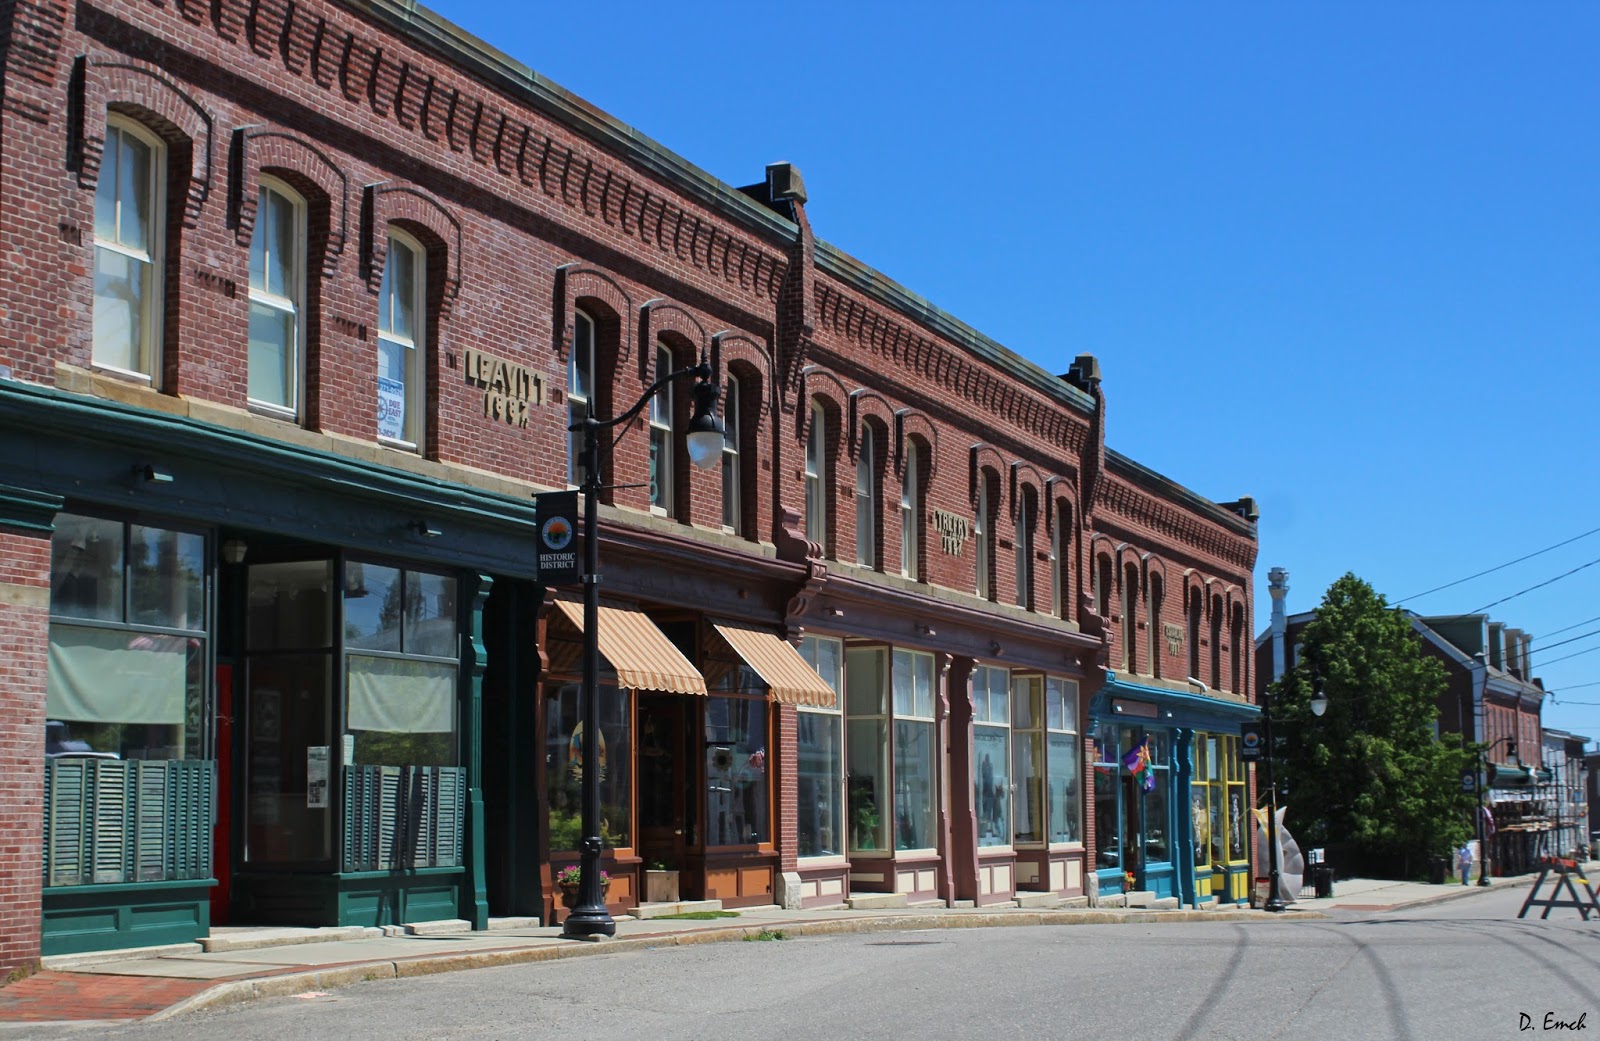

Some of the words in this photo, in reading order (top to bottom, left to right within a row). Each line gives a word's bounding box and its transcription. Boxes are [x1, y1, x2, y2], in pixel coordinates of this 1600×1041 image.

[465, 350, 547, 406] LEAVITT
[388, 399, 401, 410] DUE
[388, 407, 402, 418] EAST
[540, 552, 576, 562] HISTORIC
[540, 560, 575, 570] DISTRICT
